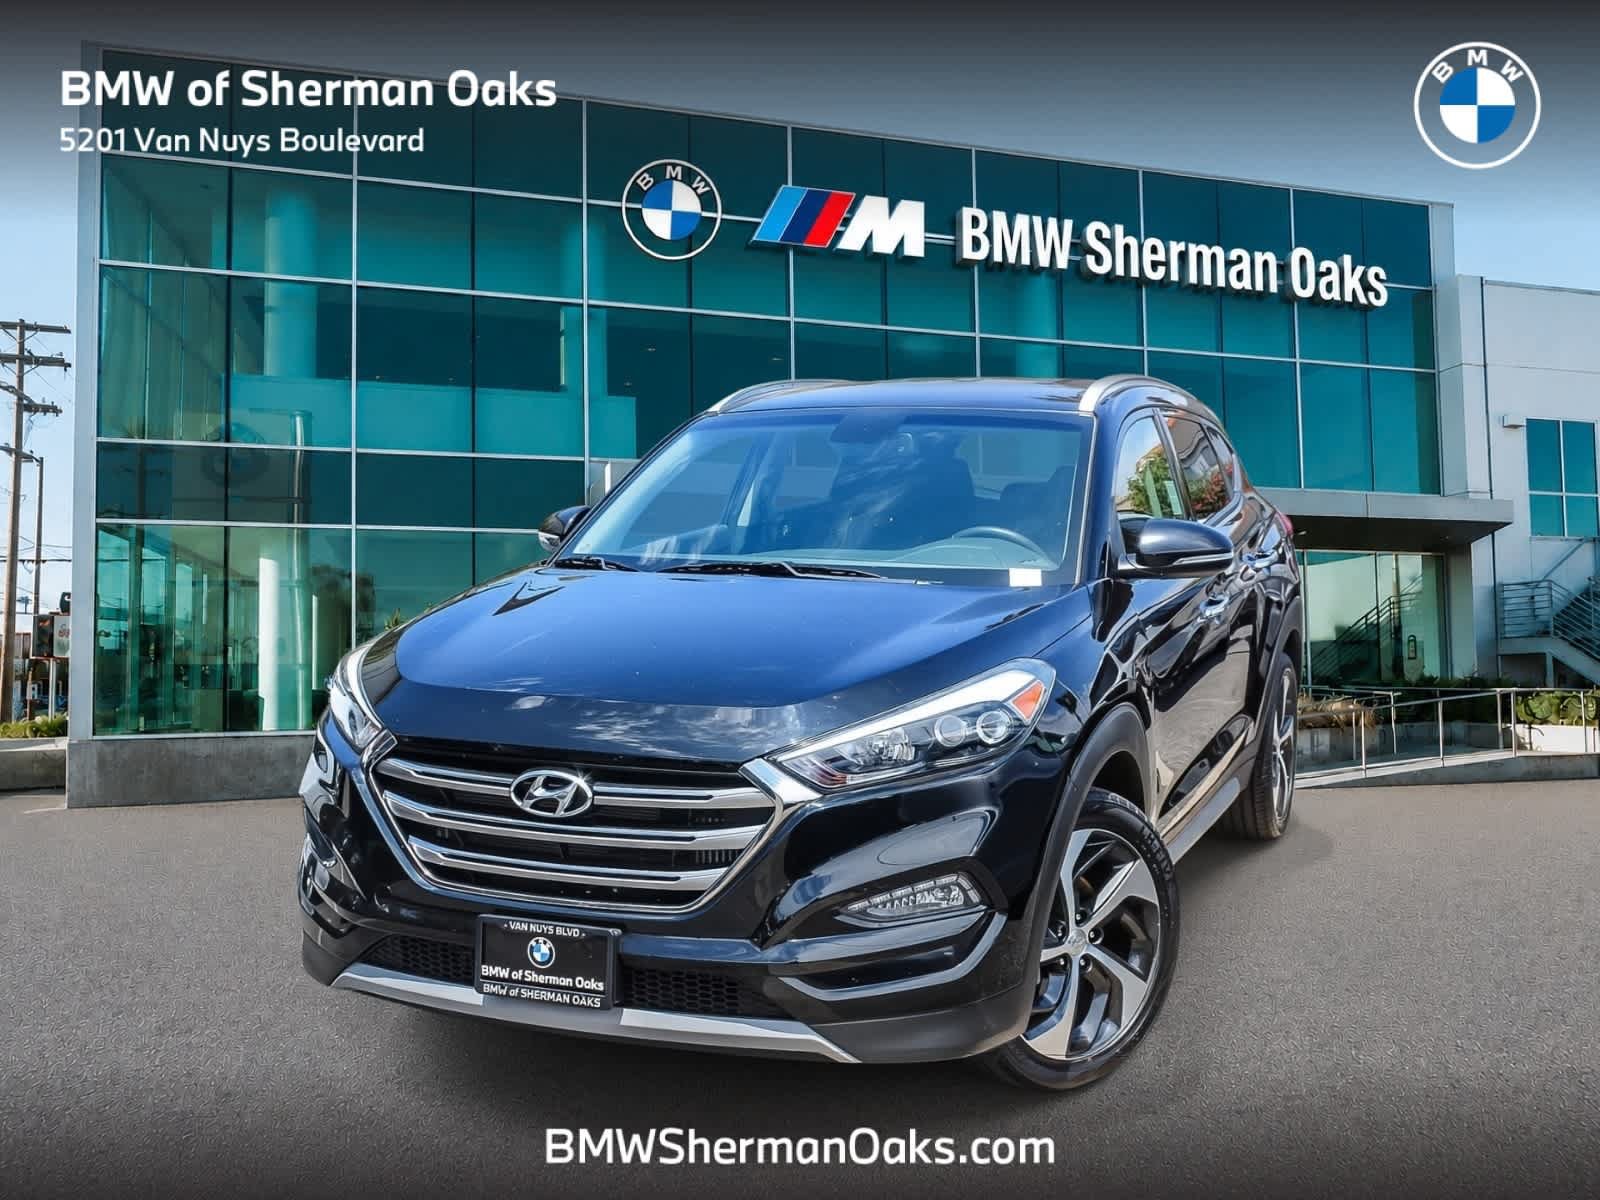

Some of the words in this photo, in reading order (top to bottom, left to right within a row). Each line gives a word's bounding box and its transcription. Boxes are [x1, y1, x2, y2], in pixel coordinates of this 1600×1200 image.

[636, 164, 710, 196] BMW
[961, 206, 1073, 270] BMW
[1085, 220, 1278, 294] Sherman
[1290, 246, 1389, 307] Oaks
[508, 920, 528, 931] VAN
[529, 923, 554, 935] NUYS
[555, 926, 580, 938] BLVD
[481, 964, 510, 979] BMW
[511, 969, 523, 980] of
[524, 970, 573, 987] Sherman
[575, 976, 605, 991] Oaks
[482, 983, 508, 996] BMW
[509, 988, 520, 998] of
[520, 989, 570, 1004] SHERMAN
[572, 996, 601, 1008] OAKS
